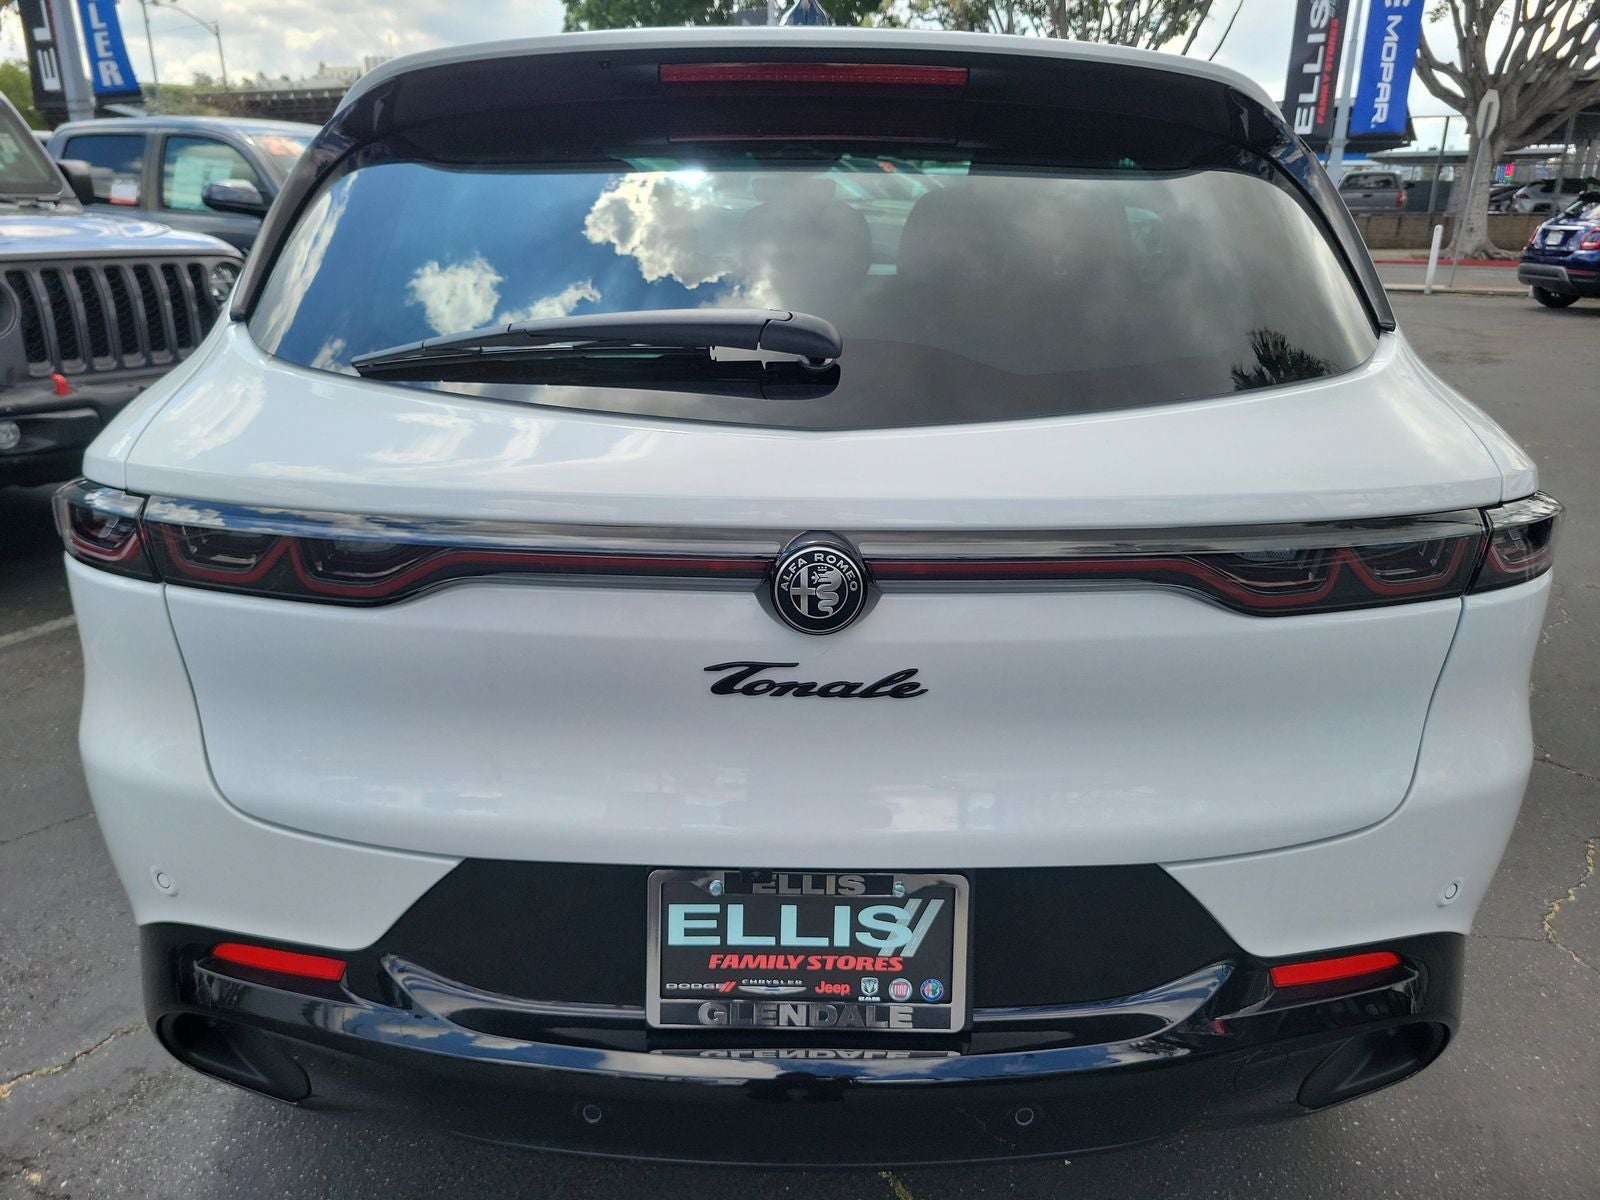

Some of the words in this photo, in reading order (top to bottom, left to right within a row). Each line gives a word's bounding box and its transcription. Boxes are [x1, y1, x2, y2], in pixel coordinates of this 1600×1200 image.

[88, 2, 125, 87] LER
[1294, 0, 1331, 135] ELLIS
[1371, 15, 1402, 125] MOPAR
[780, 557, 807, 591] ALFA
[814, 553, 858, 591] ROMEO
[703, 661, 929, 699] Tonale
[667, 903, 914, 949] ELLIS
[708, 954, 805, 971] FAMILY
[806, 955, 904, 972] STORES
[665, 982, 724, 990] DODGE
[815, 980, 851, 996] Jeep
[697, 1001, 914, 1029] GLENDALE
